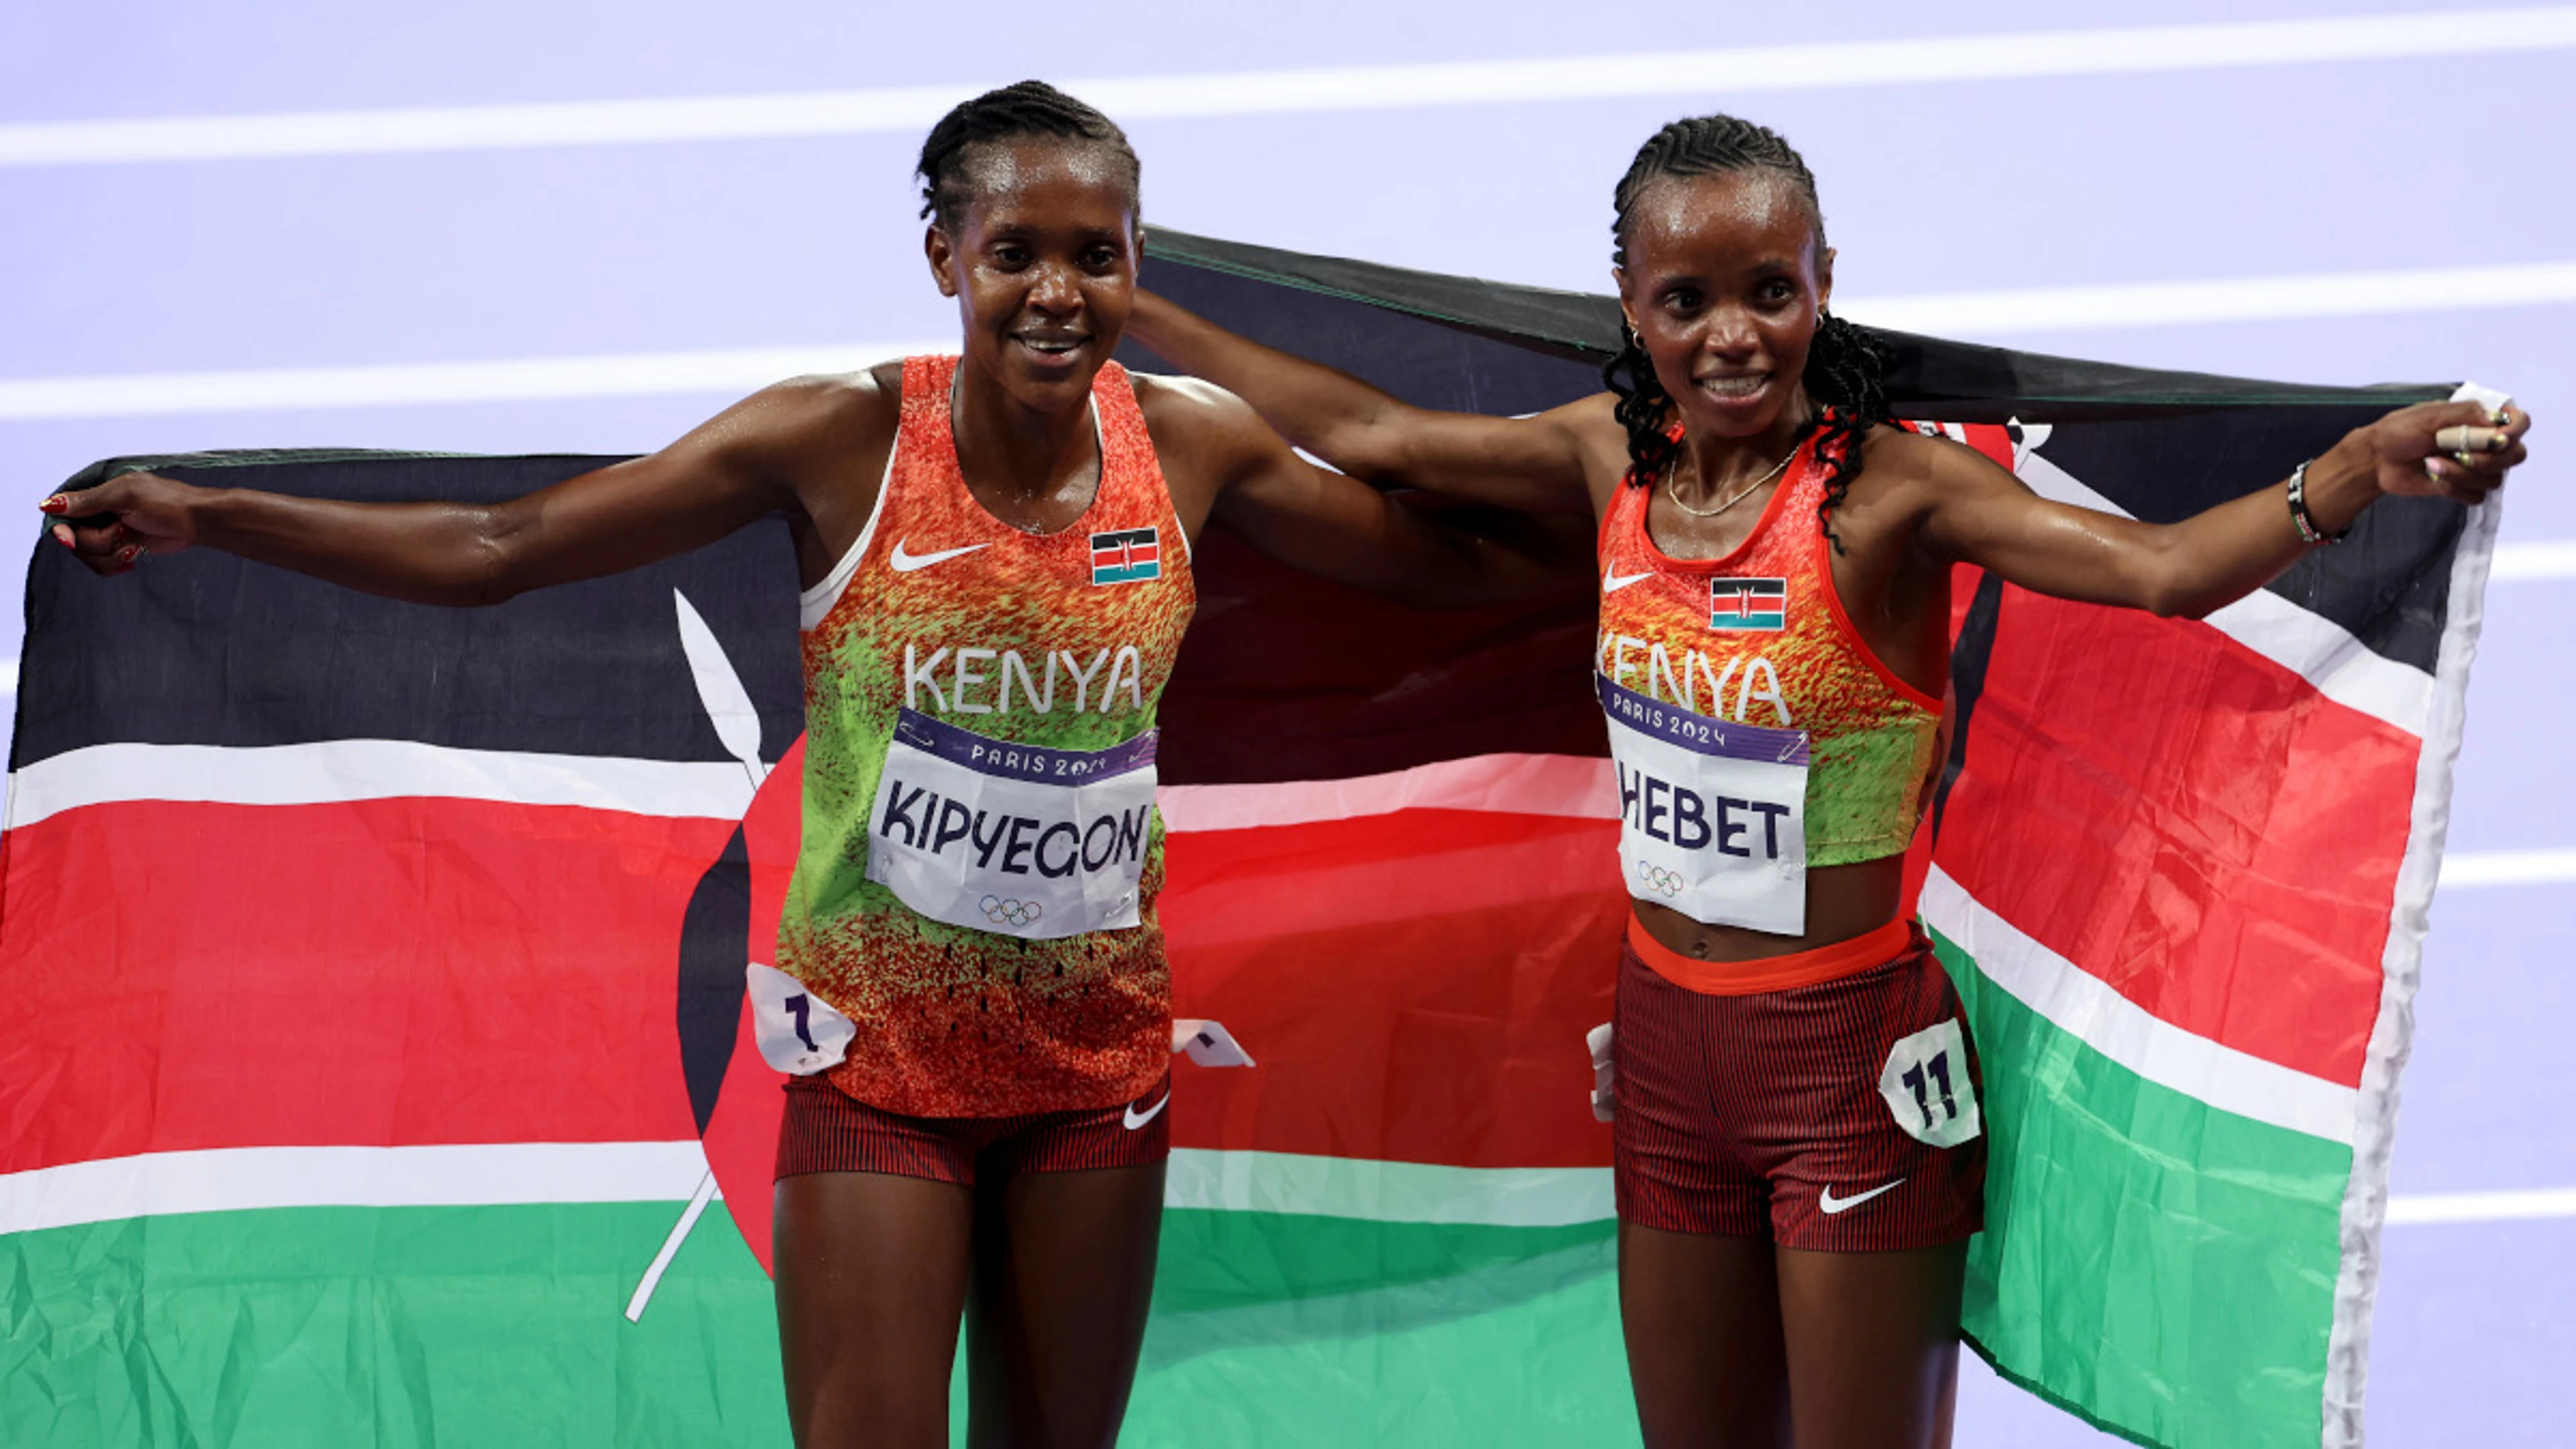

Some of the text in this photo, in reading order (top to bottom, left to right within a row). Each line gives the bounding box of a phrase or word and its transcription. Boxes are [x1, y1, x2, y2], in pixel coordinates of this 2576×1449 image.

[905, 644, 1142, 714] KENYA
[1596, 627, 1792, 726] KENYA
[971, 744, 1046, 773] PARIS
[1613, 692, 1725, 747] PARIS 2024
[880, 779, 1147, 879] KIPYEGON
[1619, 759, 1790, 859] HEBET
[1901, 1048, 1957, 1130] 11
